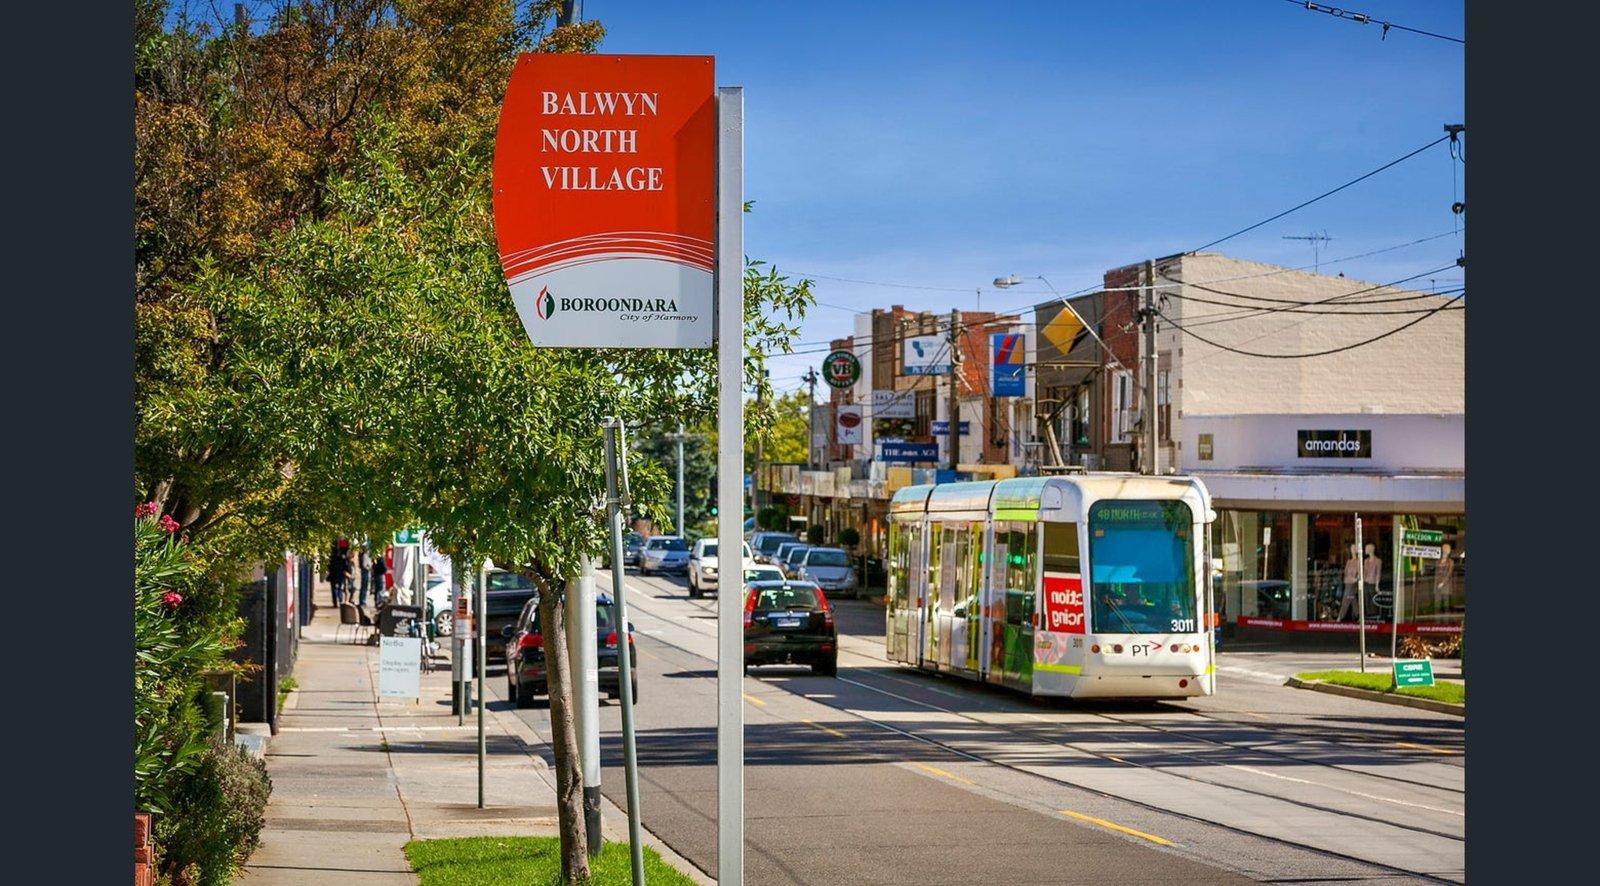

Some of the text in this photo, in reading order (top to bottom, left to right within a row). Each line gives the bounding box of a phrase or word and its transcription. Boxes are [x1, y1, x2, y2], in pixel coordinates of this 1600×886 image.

[541, 91, 659, 116] BALWYN
[541, 129, 638, 153] NORTH
[541, 166, 664, 191] VILLAGE
[560, 298, 678, 312] BOROONDARA
[620, 313, 698, 322] City of Harmony
[1305, 433, 1361, 451] amandas
[1111, 508, 1140, 520] NORTH
[1170, 619, 1194, 632] 3011
